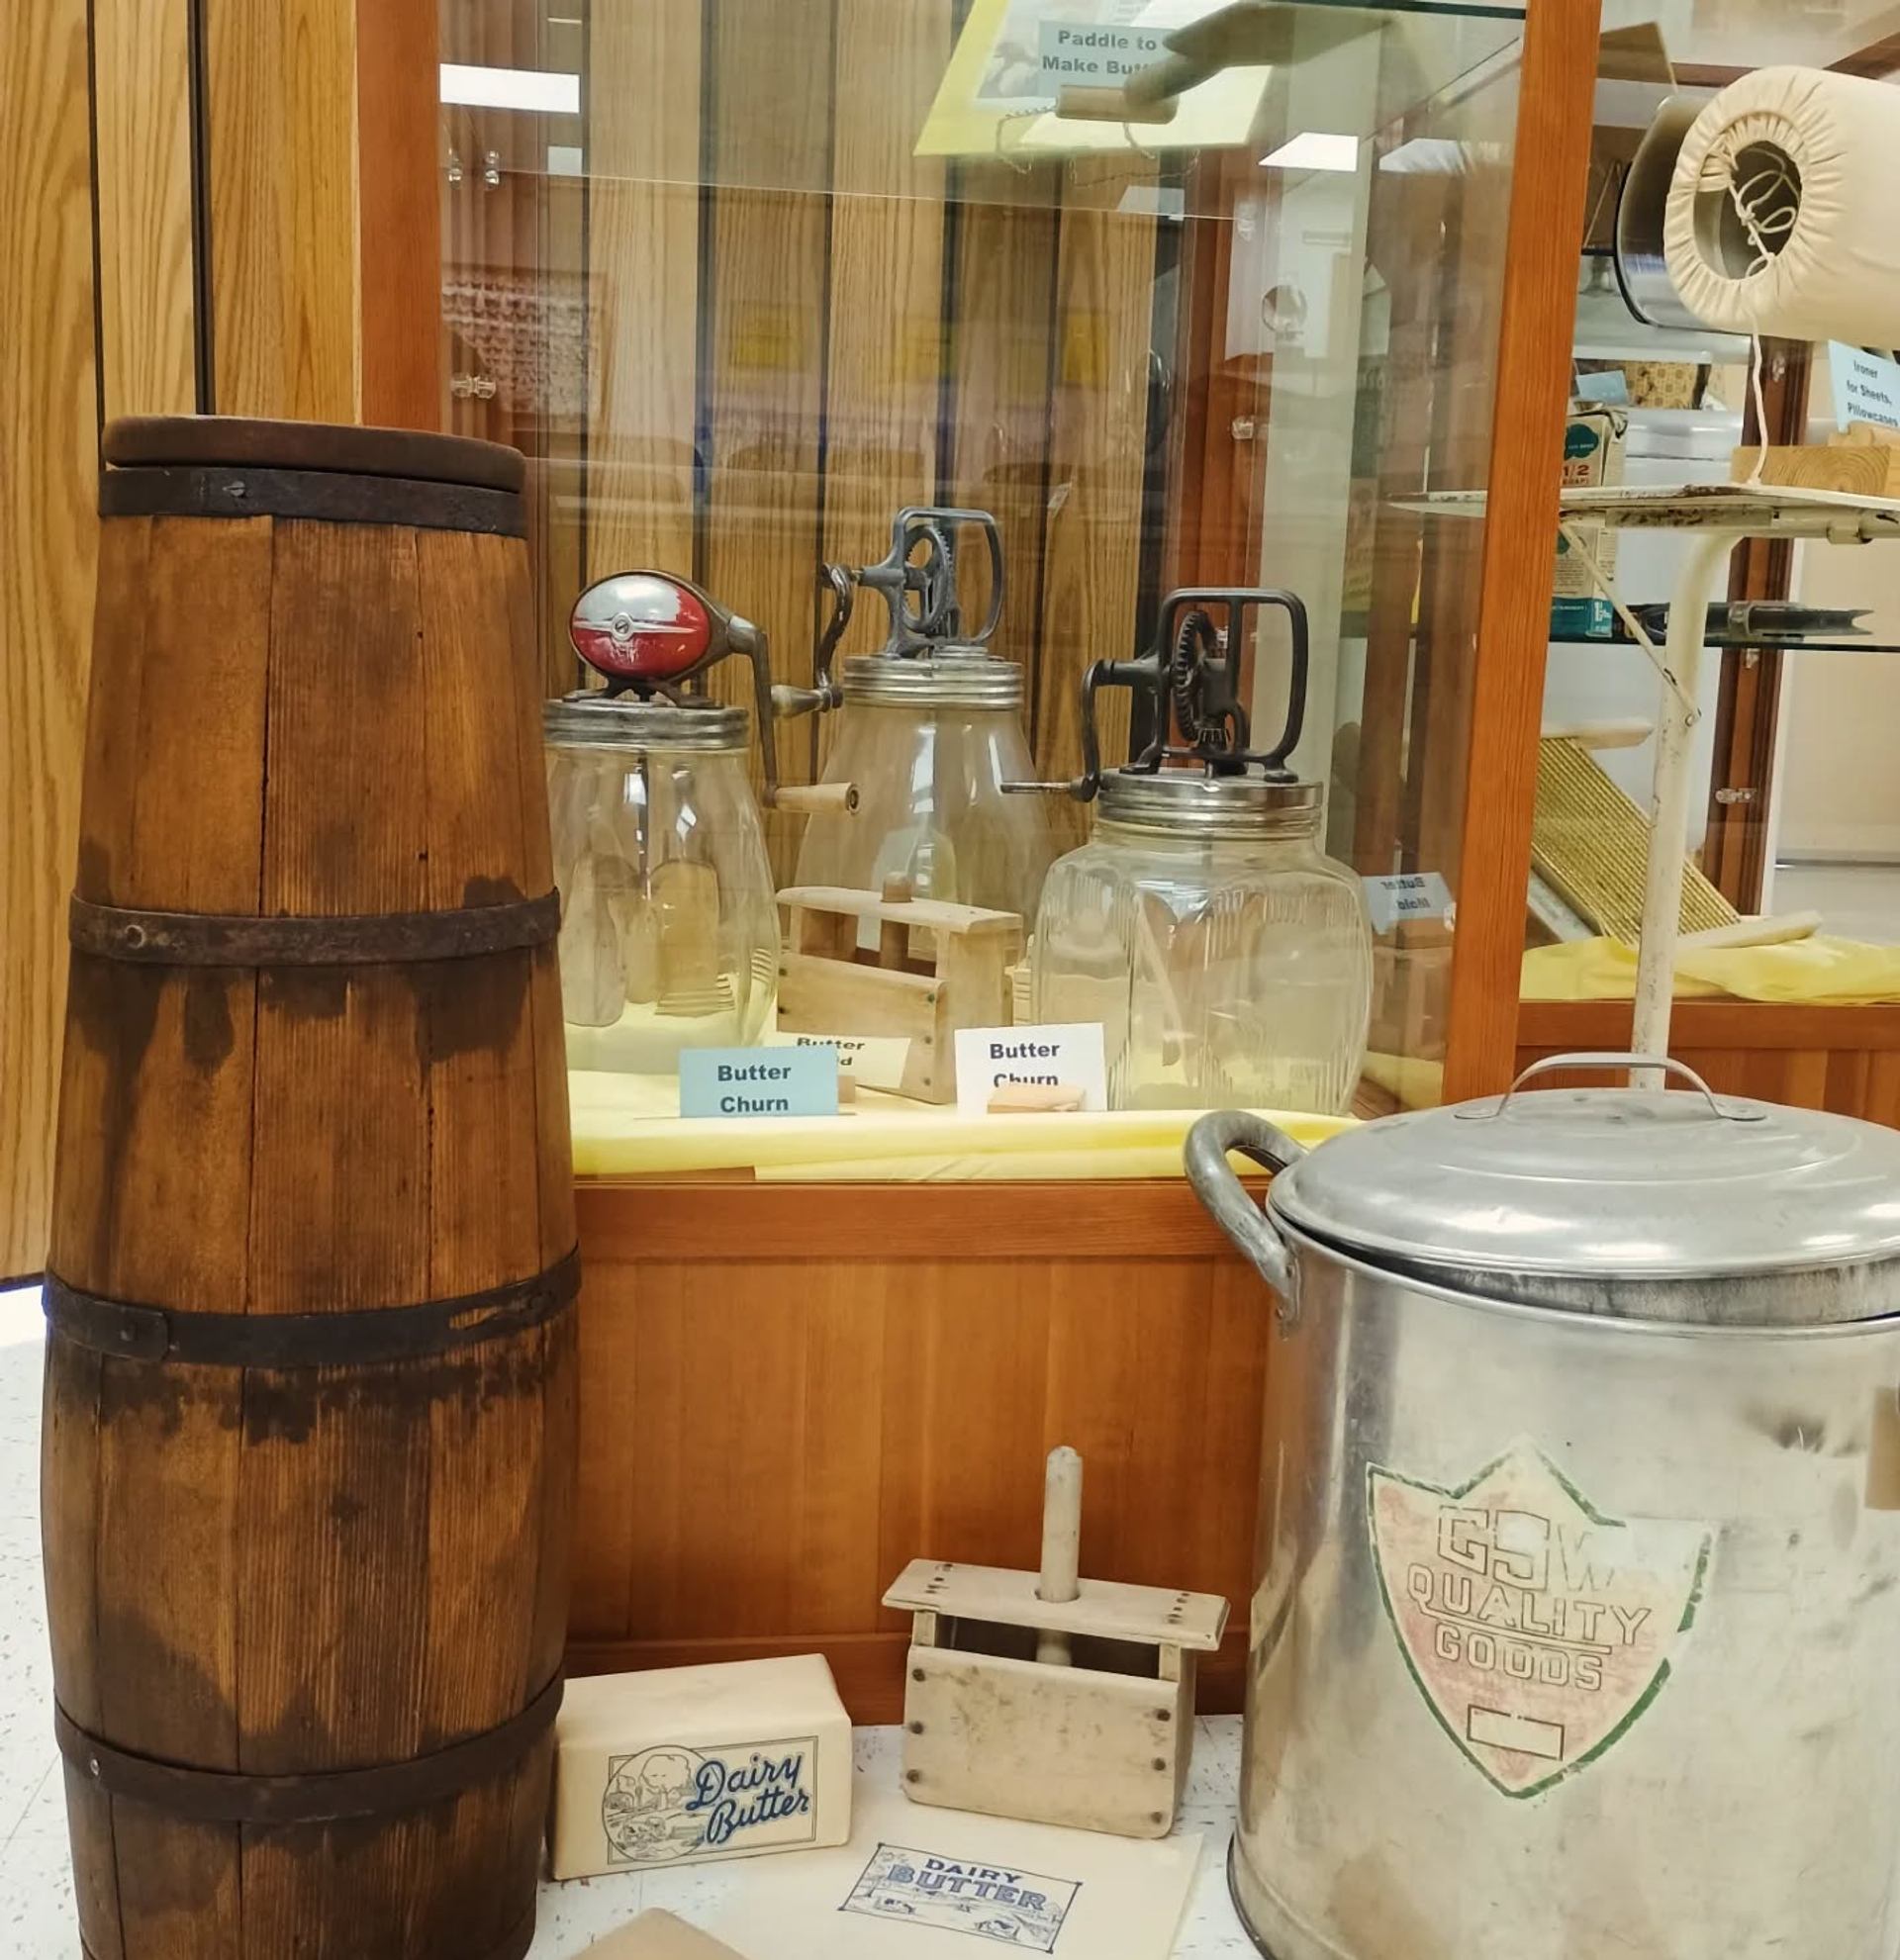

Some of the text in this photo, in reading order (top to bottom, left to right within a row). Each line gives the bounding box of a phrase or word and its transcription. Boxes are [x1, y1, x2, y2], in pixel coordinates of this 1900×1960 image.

[1058, 30, 1157, 51] Paddle to
[1042, 55, 1098, 74] Make
[1853, 359, 1878, 379] Ironer
[1847, 379, 1857, 394] for
[990, 1043, 1061, 1059] Butter
[717, 1064, 792, 1081] Butter
[720, 1095, 789, 1113] Churn
[1407, 1563, 1652, 1646] QUALITY
[1435, 1621, 1603, 1692] GOODS
[685, 1754, 804, 1811] Dairy
[707, 1785, 809, 1843] Butter
[925, 1858, 1024, 1884] DAIRY
[887, 1864, 1049, 1912] BUTTER
